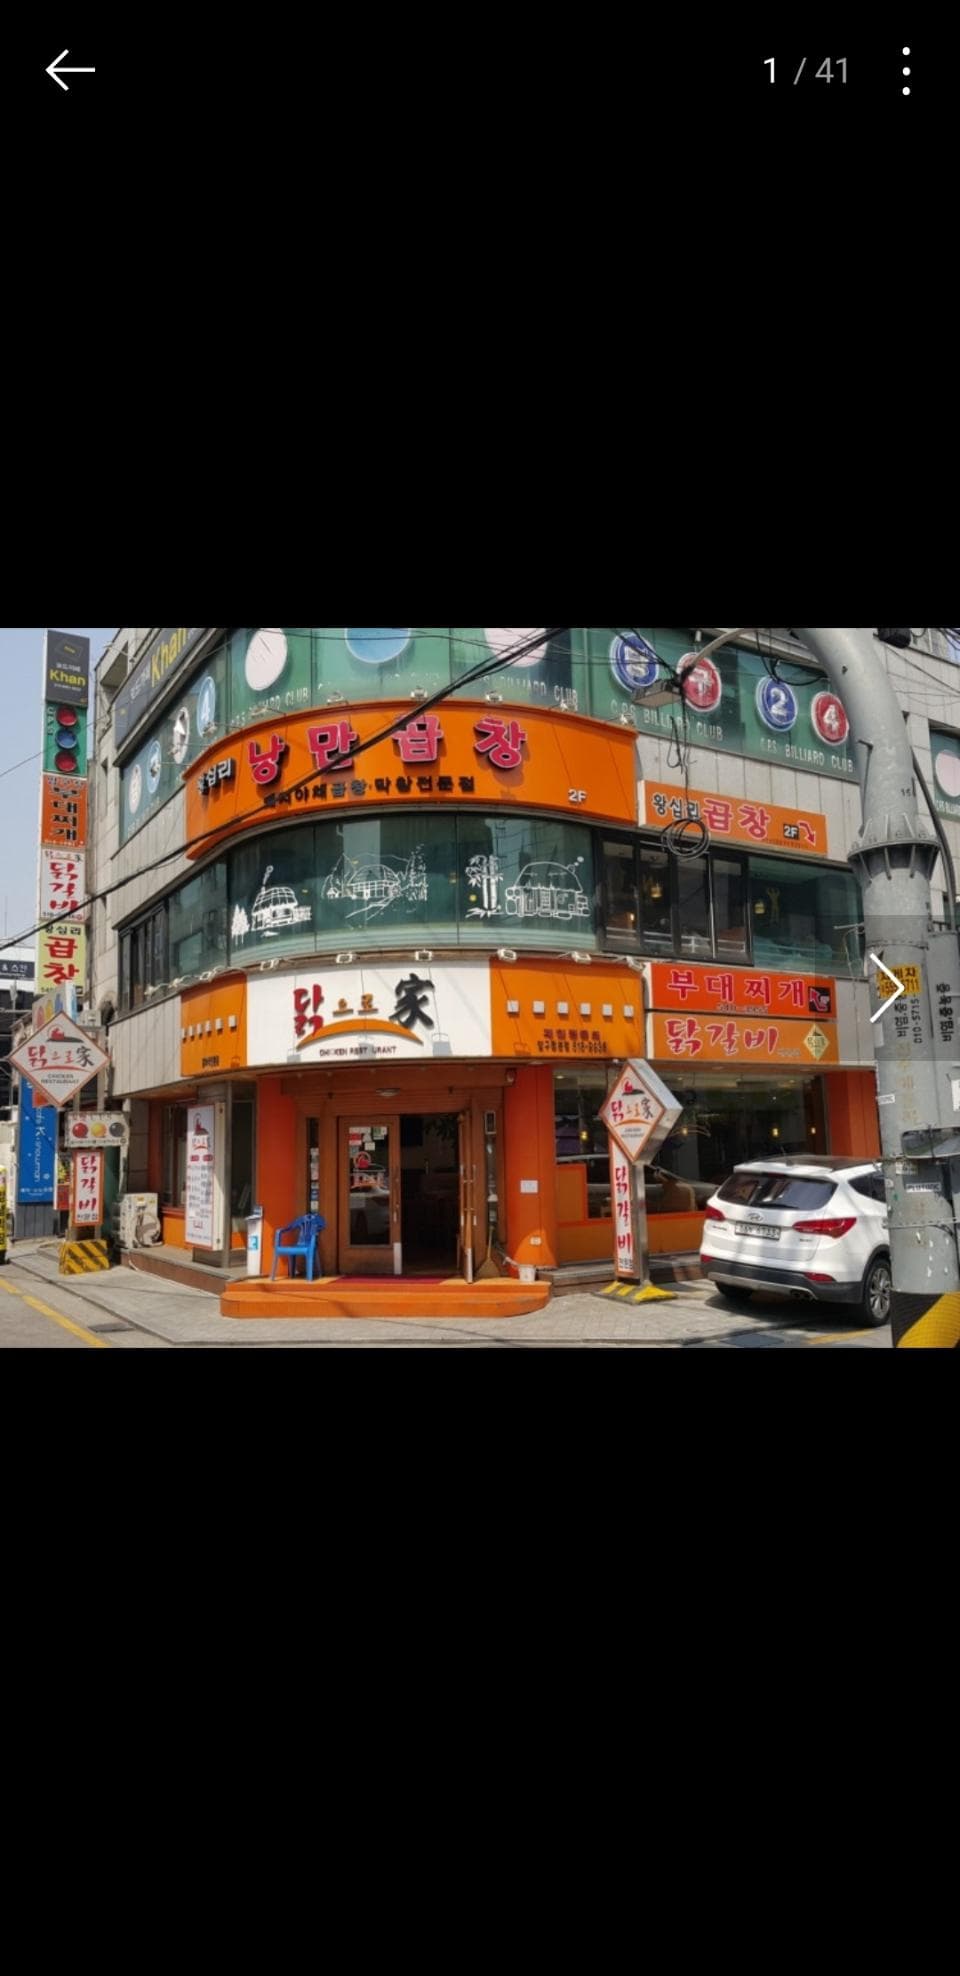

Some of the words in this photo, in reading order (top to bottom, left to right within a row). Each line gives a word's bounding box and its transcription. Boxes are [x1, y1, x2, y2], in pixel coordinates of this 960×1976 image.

[49, 668, 87, 687] Khan
[785, 743, 825, 767] BILLIARD
[831, 755, 854, 773] CLUB
[52, 785, 80, 842] 부대찌개
[568, 788, 588, 803] 2F
[702, 797, 770, 841] 곱창
[784, 825, 799, 838] 2F
[50, 861, 79, 914] 닭갈비
[43, 936, 81, 985] 곱창
[667, 969, 806, 1007] 부대찌개
[665, 1017, 780, 1056] 닭갈비
[78, 1155, 98, 1211] 닭갈비
[615, 1166, 632, 1254] 닭갈비
